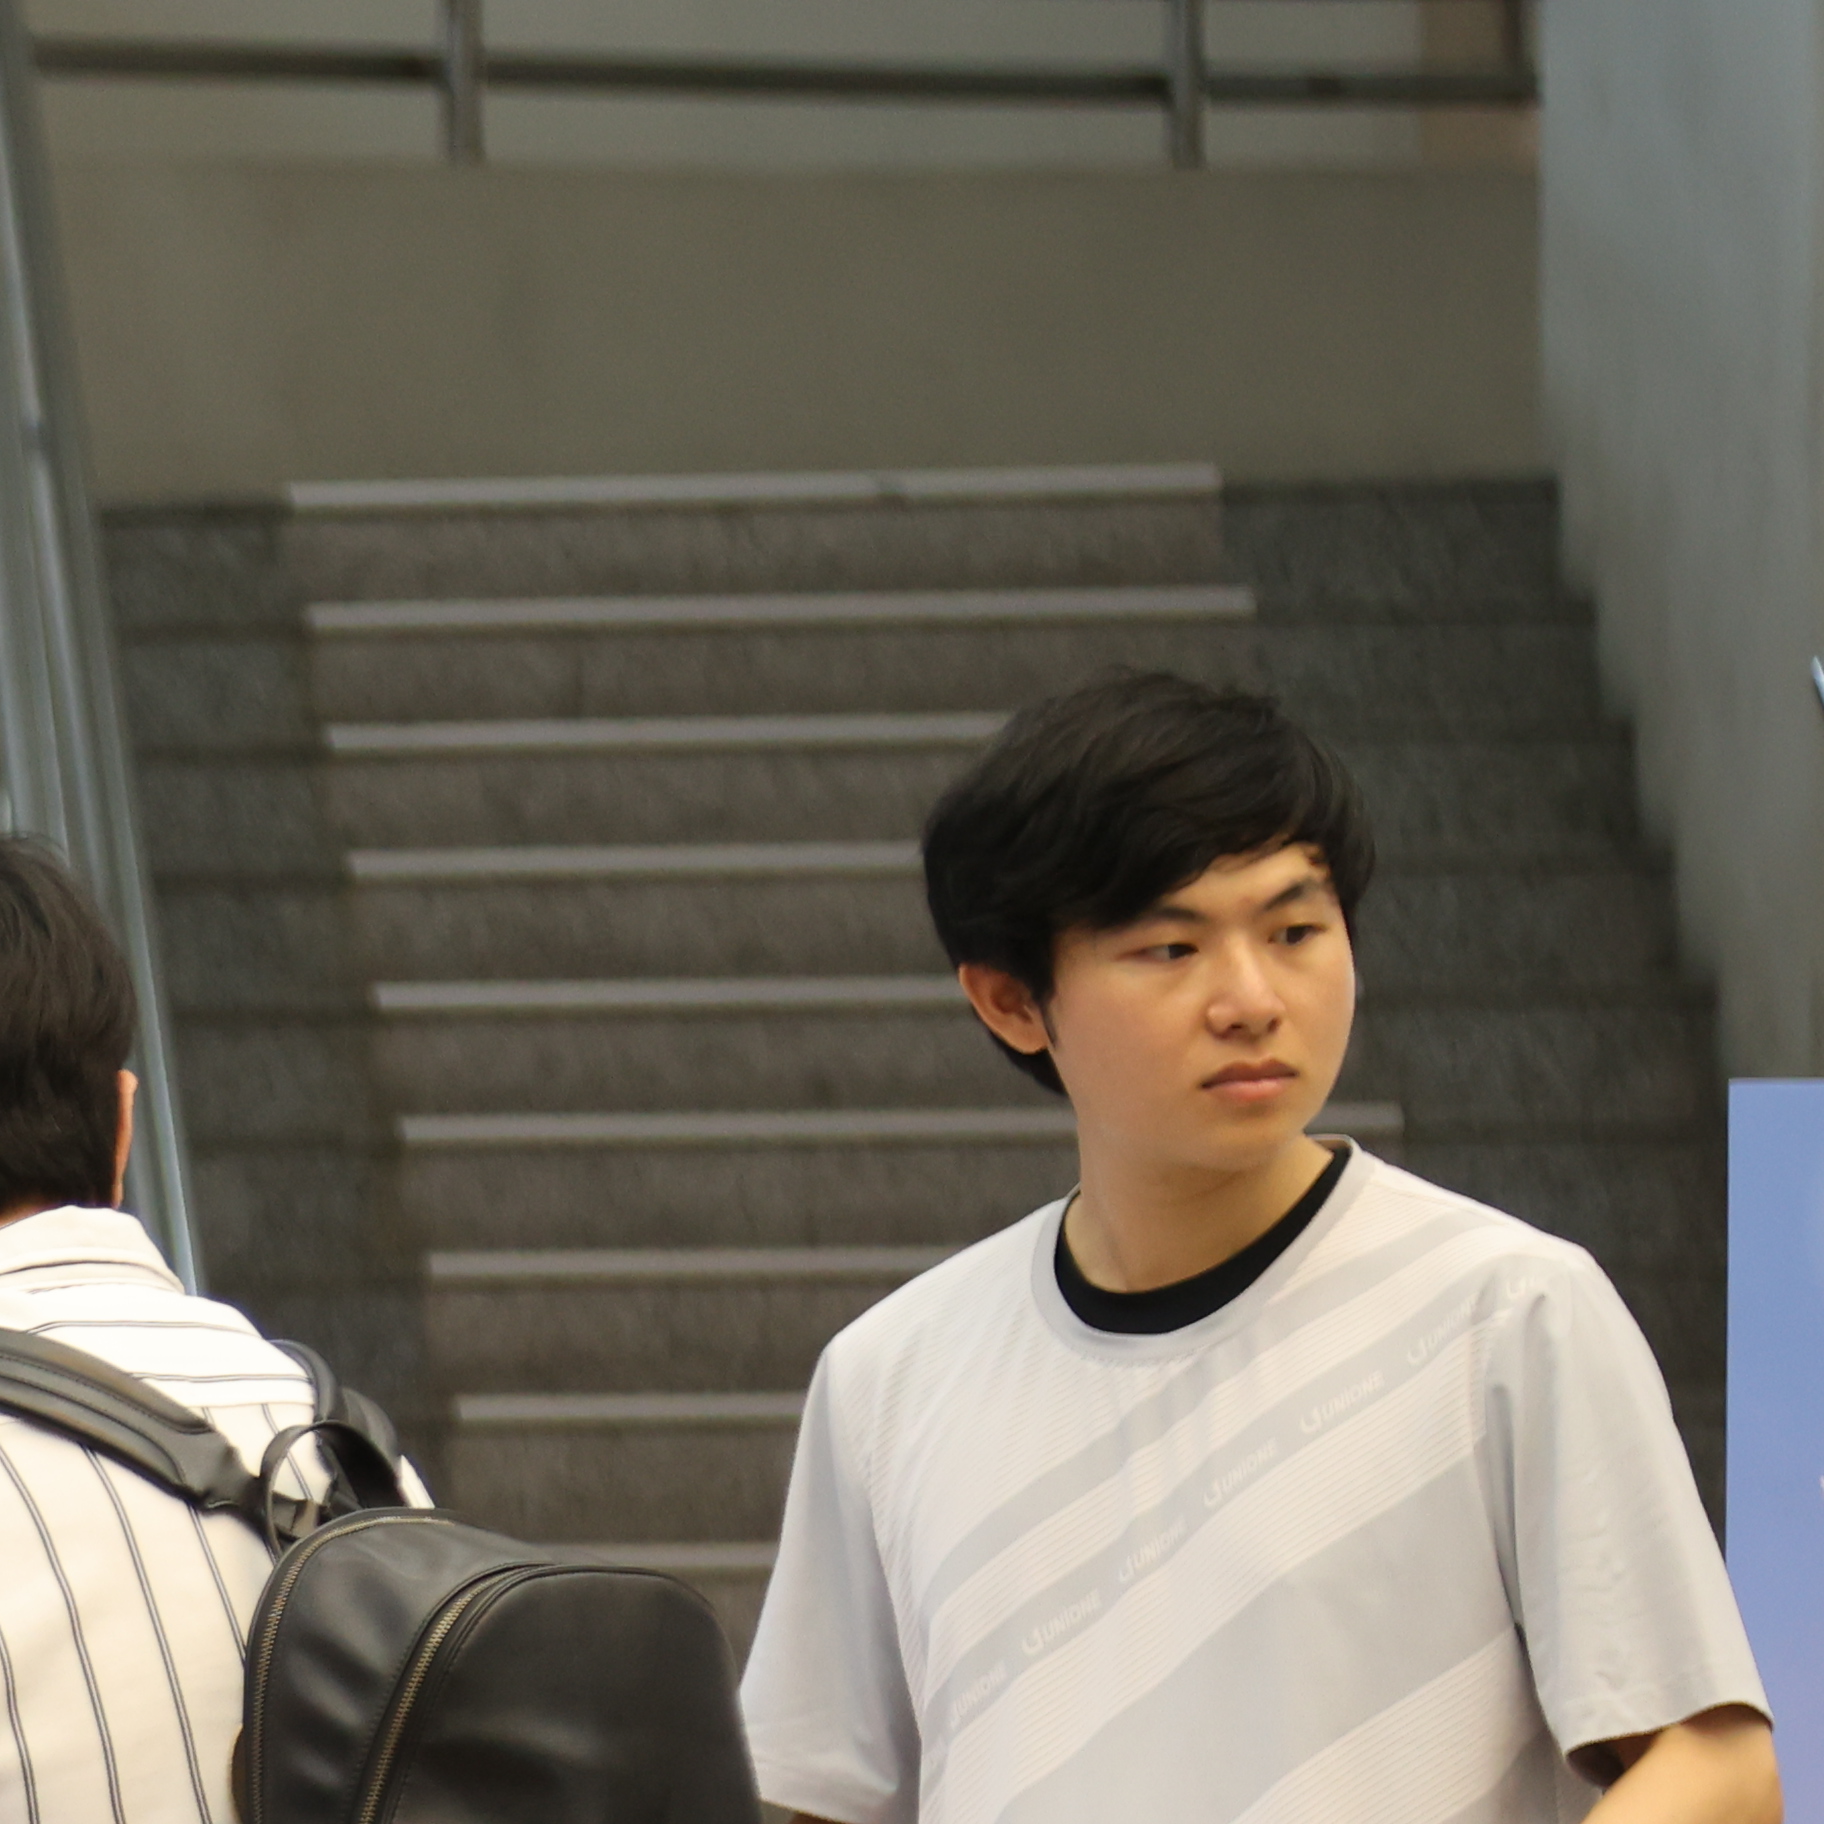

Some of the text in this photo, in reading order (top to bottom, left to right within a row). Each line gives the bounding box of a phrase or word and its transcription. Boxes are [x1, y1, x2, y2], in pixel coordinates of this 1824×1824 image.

[1043, 1590, 1104, 1645] UNIONE
[1222, 1437, 1278, 1493] UNIONE
[1320, 1371, 1387, 1428] UNIONE
